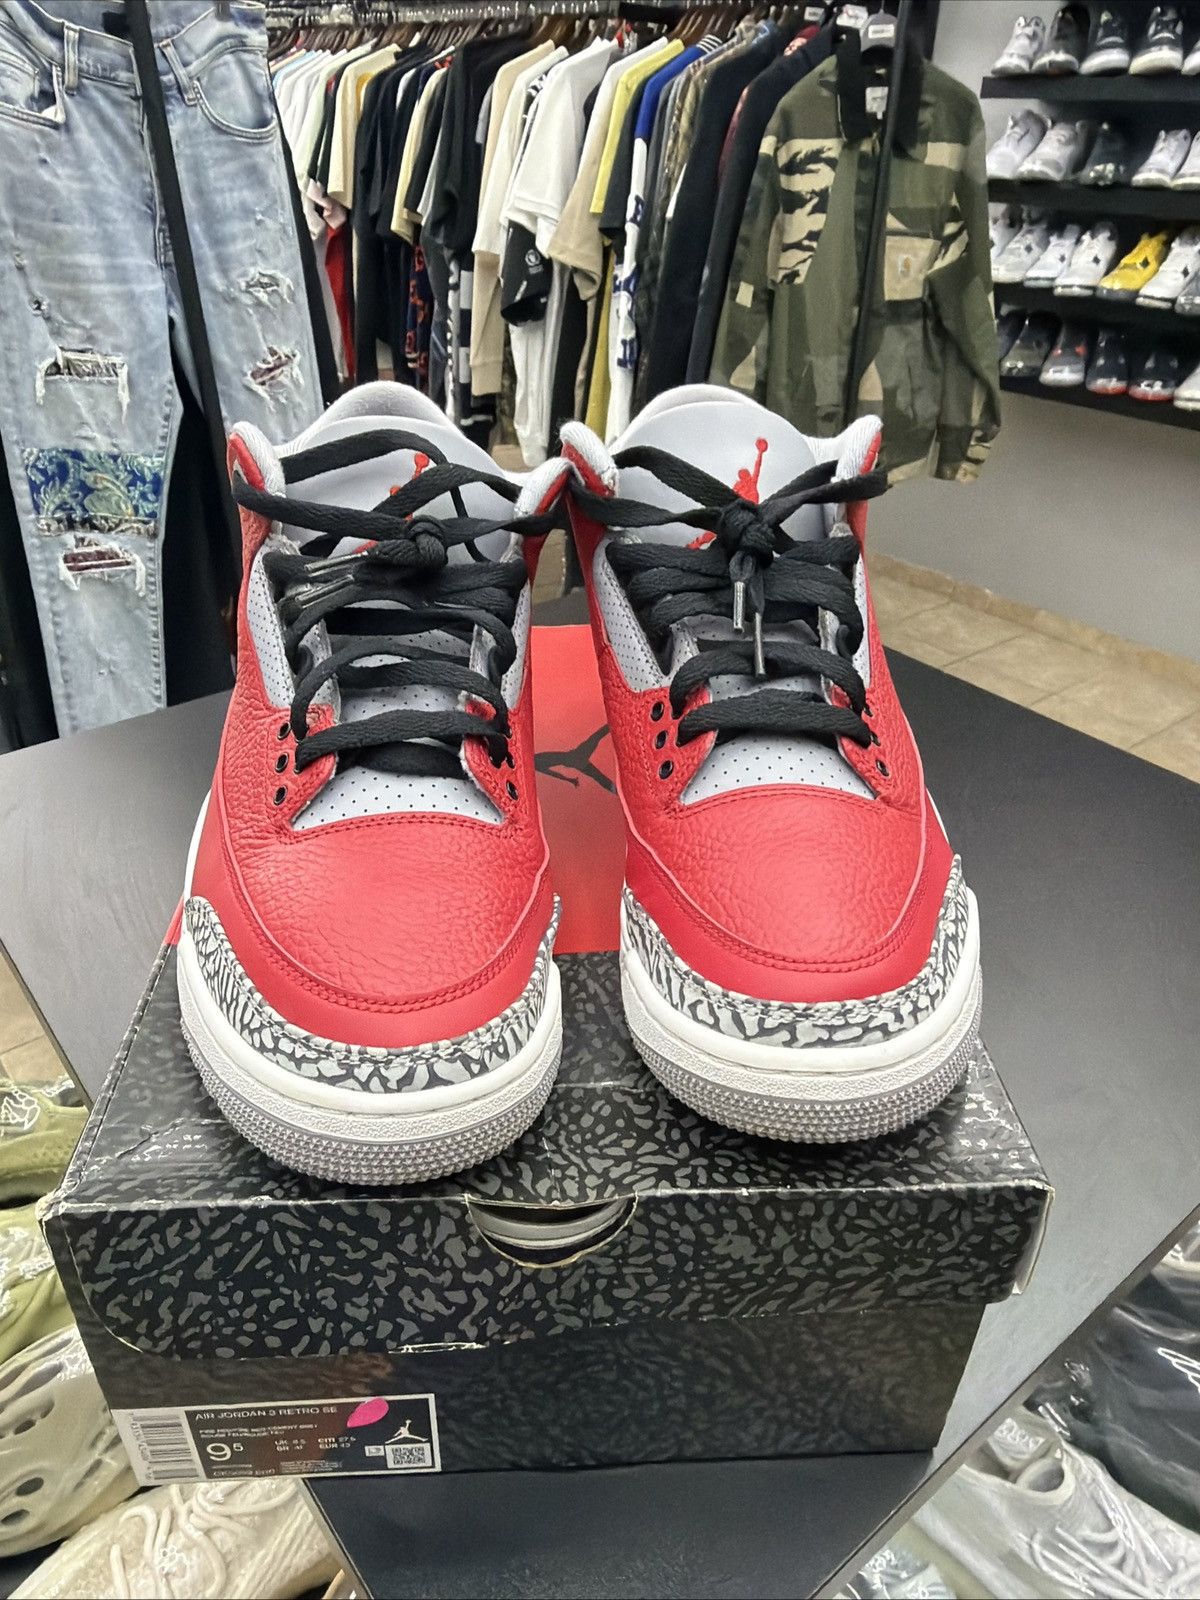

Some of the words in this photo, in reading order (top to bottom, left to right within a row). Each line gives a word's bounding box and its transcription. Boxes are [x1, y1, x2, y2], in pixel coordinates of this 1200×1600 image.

[195, 1412, 214, 1421] AIR
[217, 1410, 267, 1419] JORDAN
[279, 1407, 320, 1416] RETRO
